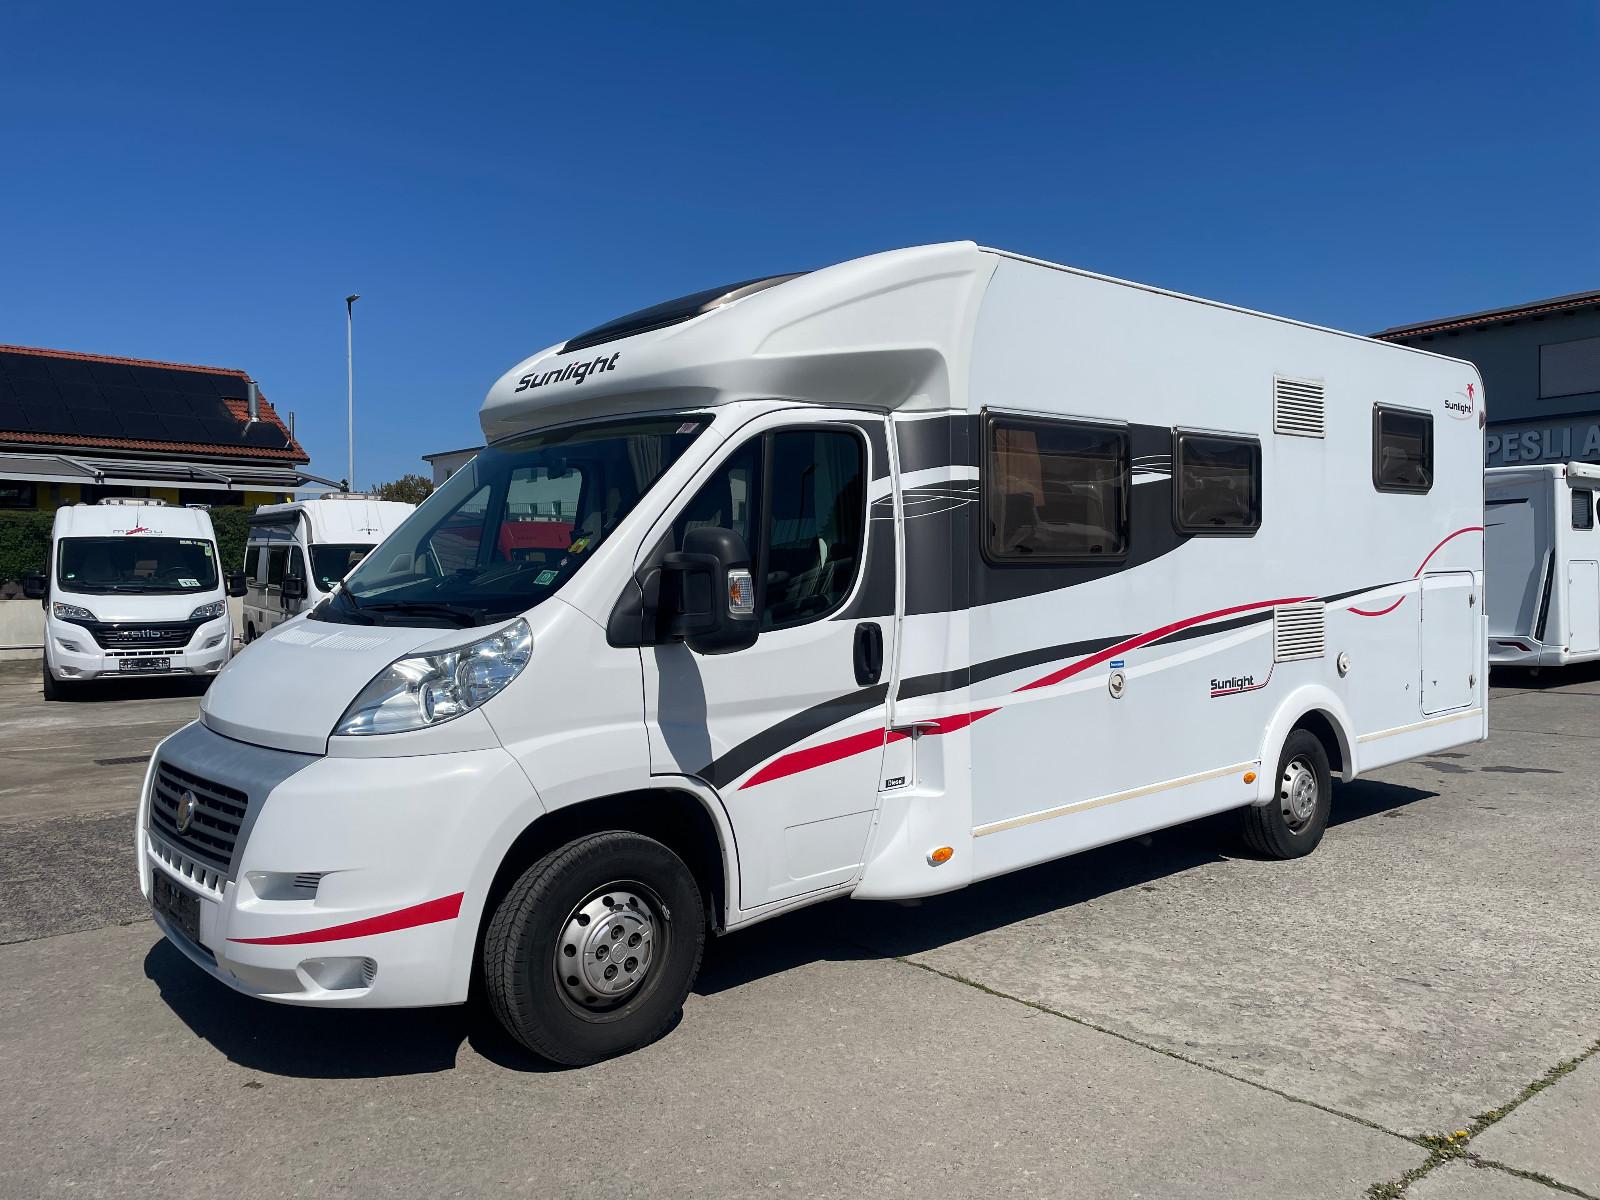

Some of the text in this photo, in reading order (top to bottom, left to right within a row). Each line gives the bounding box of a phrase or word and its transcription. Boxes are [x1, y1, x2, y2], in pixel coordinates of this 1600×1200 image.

[515, 352, 620, 393] Sunlight
[1444, 400, 1472, 414] Sunlight
[1211, 676, 1254, 690] Sunlight
